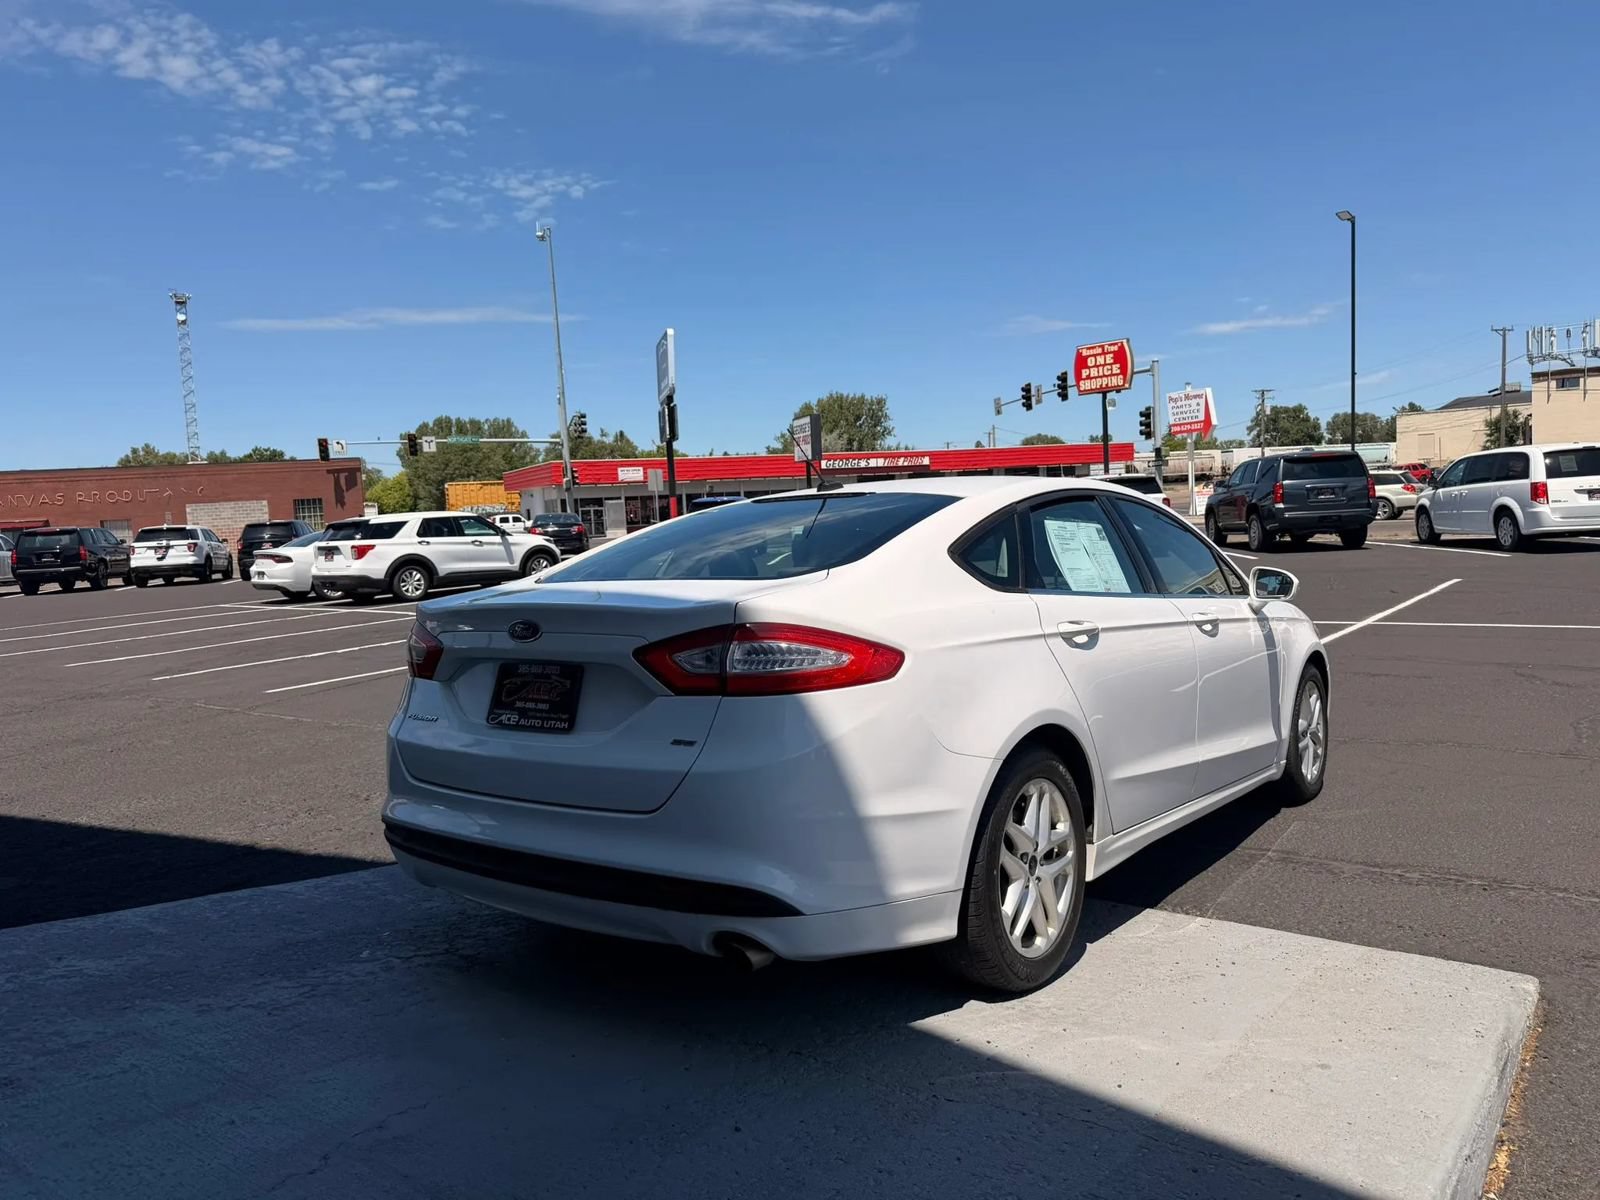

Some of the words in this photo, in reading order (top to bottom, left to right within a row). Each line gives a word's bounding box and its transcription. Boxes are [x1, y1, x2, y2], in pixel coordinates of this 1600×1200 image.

[1087, 353, 1114, 367] ONE
[1081, 363, 1121, 379] PRICE
[1079, 375, 1124, 391] SHOPPING
[1168, 394, 1183, 405] Pop's
[1171, 408, 1201, 417] SERVICE
[825, 458, 871, 468] GEORGE'S
[882, 458, 900, 467] TIRE
[901, 456, 925, 466] PROS
[519, 719, 542, 727] AUTO
[543, 720, 569, 729] UTAH
